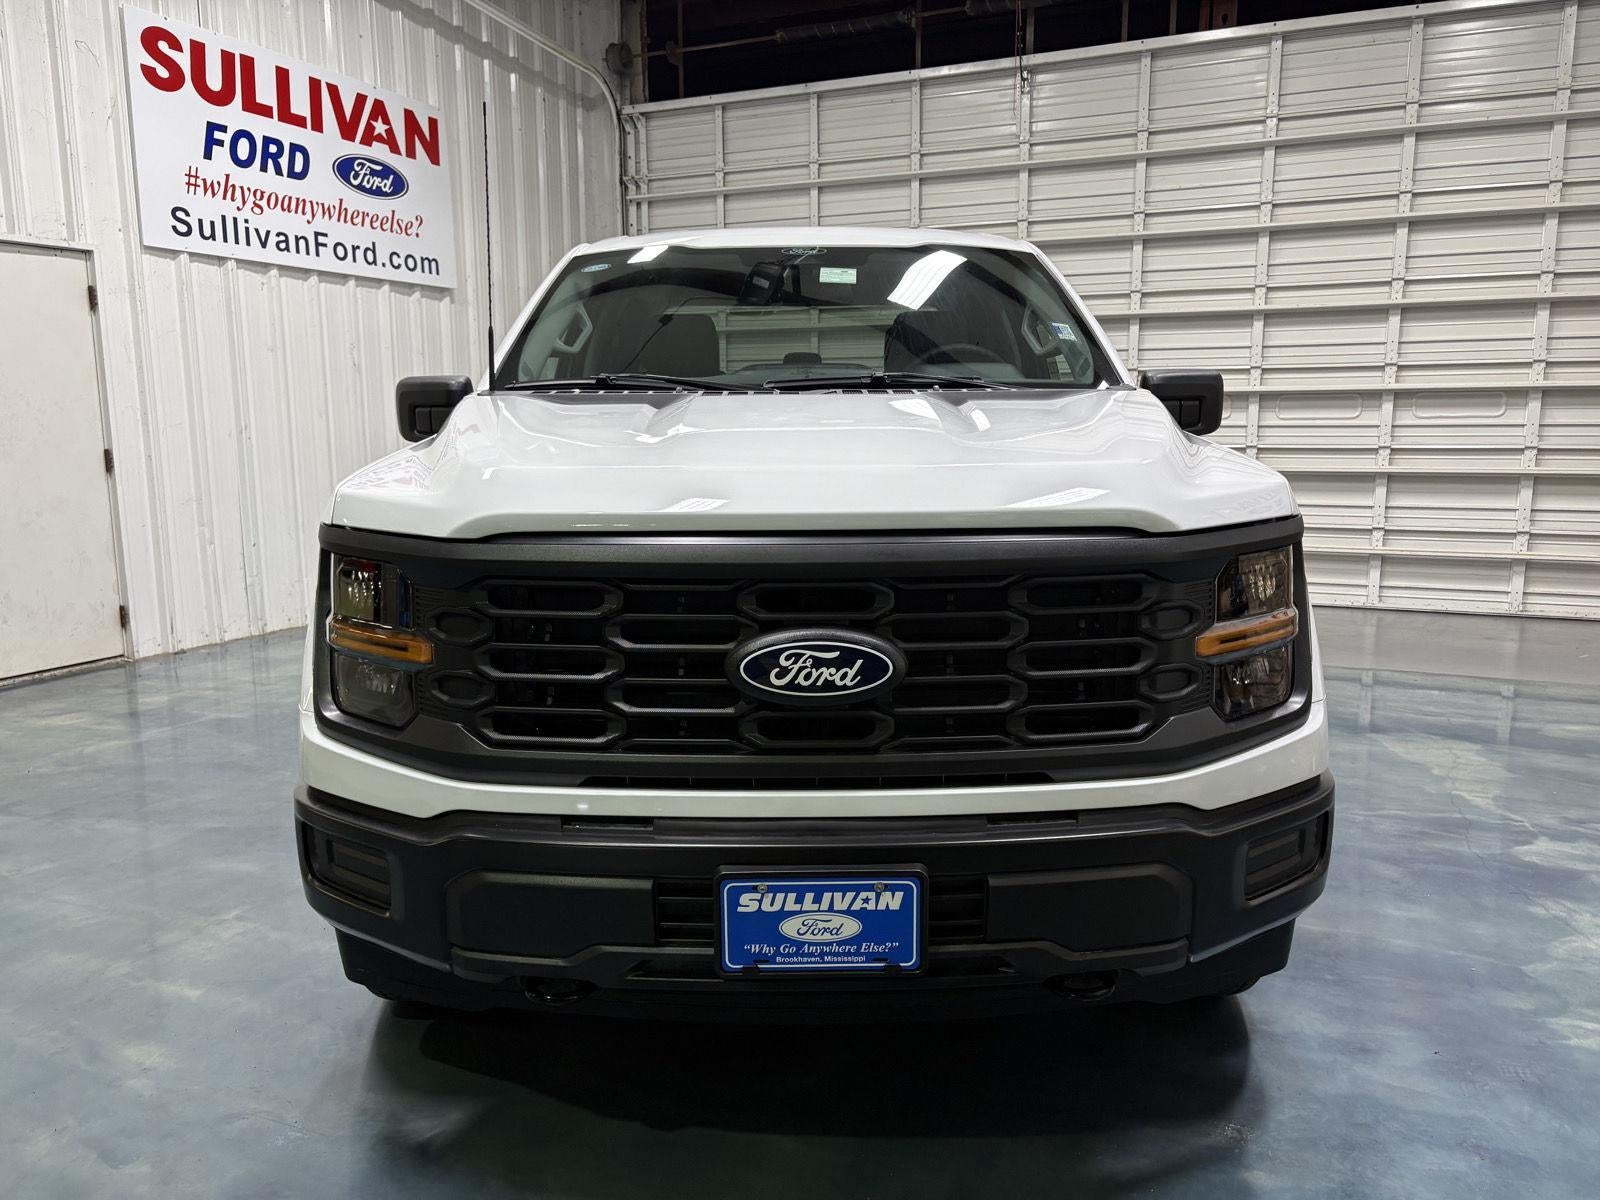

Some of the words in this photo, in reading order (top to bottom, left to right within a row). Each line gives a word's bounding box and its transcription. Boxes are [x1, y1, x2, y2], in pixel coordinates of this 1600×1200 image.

[140, 25, 441, 167] SULLIVAN
[203, 121, 311, 181] FORD
[349, 158, 395, 195] Ford
[185, 165, 424, 238] #whygoanywhereelse?
[171, 206, 440, 276] SullivanFord.com
[769, 649, 864, 687] Ford
[737, 891, 904, 913] SULLIVAN
[796, 918, 844, 937] Ford
[779, 943, 796, 954] Go
[799, 942, 857, 956] Anywhere
[824, 955, 866, 963] Mississippi
